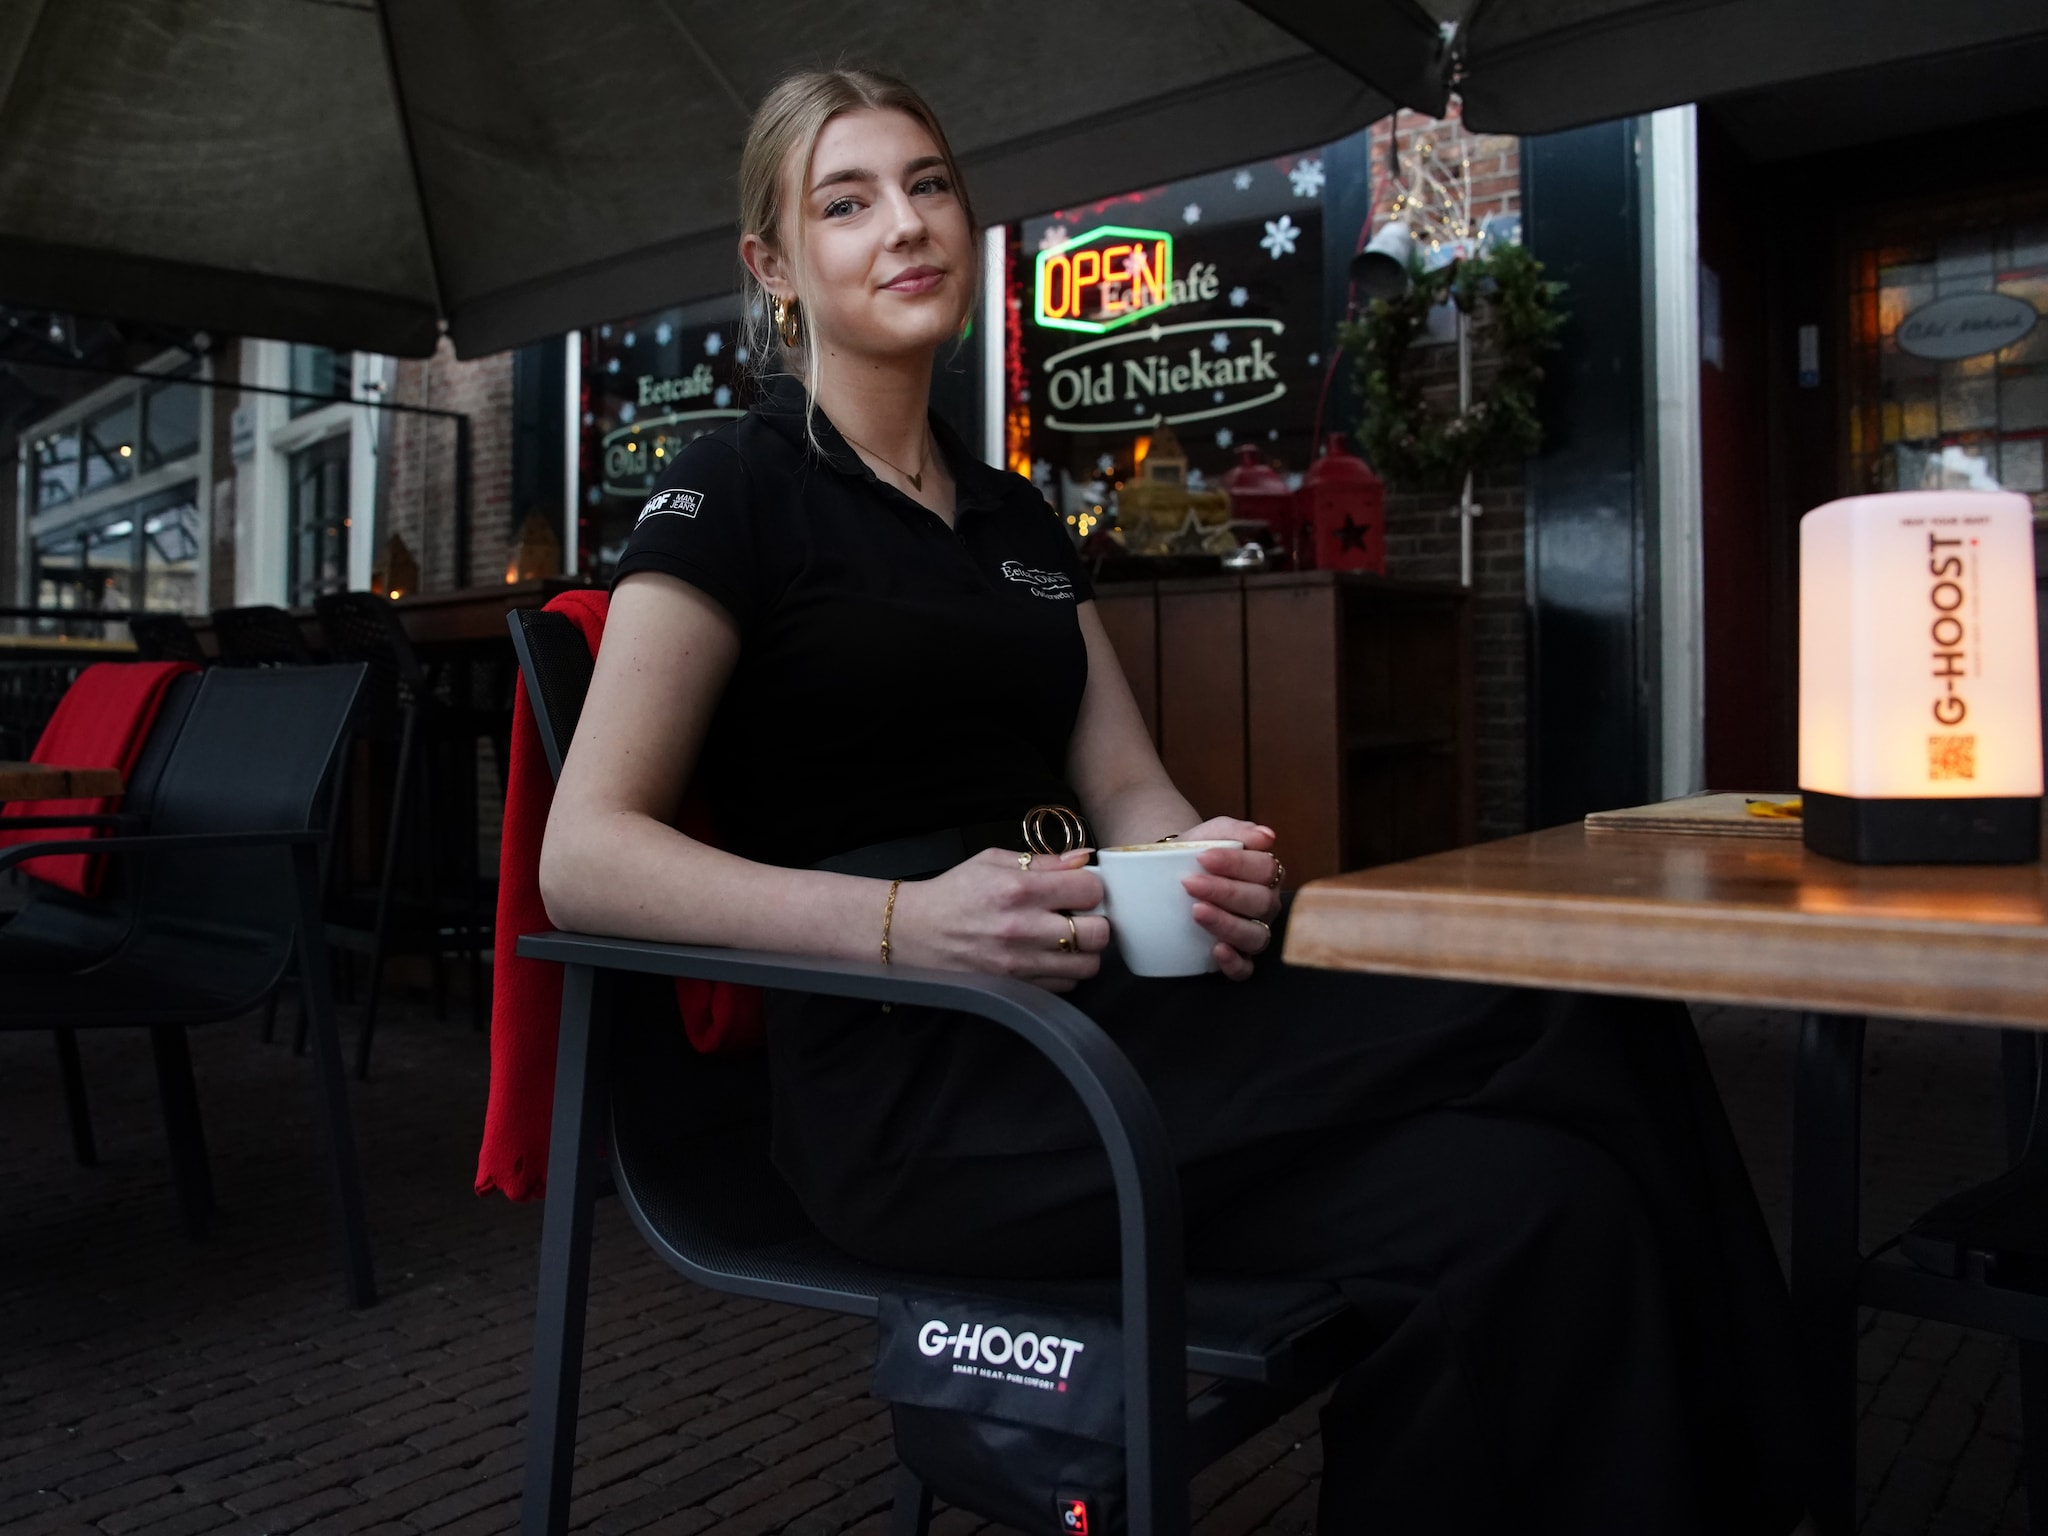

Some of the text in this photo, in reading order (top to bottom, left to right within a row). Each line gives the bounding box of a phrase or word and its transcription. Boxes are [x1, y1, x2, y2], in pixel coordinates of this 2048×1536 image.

[1043, 240, 1167, 319] OPEN
[637, 362, 715, 407] Eetcafé
[1049, 337, 1281, 412] Old Niekark
[604, 439, 648, 479] Old
[669, 499, 697, 513] JEANS
[675, 493, 696, 503] MAN
[1928, 532, 1966, 726] G-HOOST
[917, 1319, 1085, 1379] G-HOOST
[952, 1363, 979, 1376] SMART
[1006, 1372, 1024, 1385] PURE
